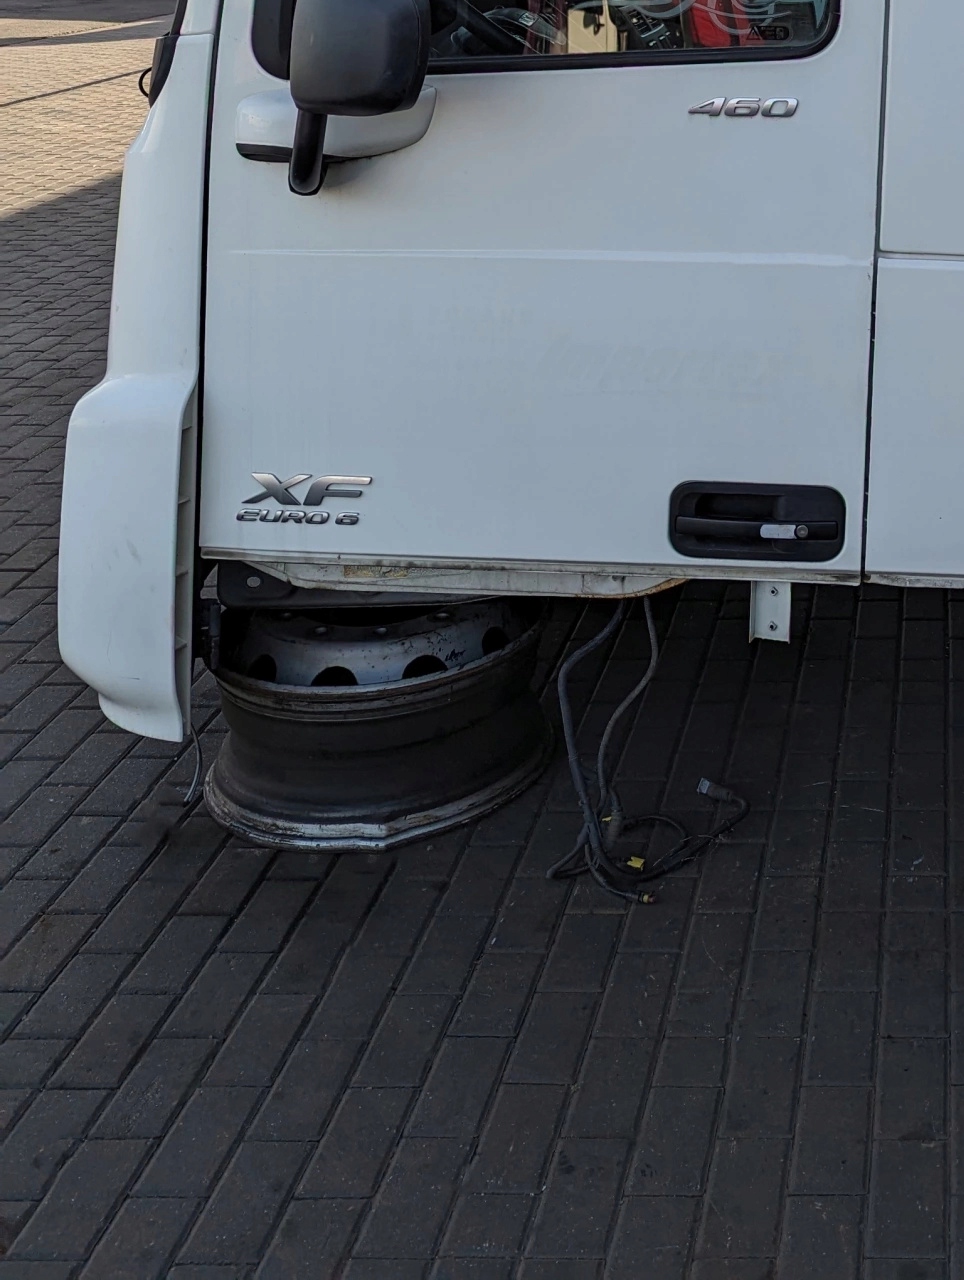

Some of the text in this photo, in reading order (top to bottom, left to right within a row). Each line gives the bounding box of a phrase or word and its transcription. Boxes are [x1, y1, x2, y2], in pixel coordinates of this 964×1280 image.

[688, 97, 799, 118] 460
[241, 472, 373, 506] XF
[236, 508, 360, 526] EURO 6
